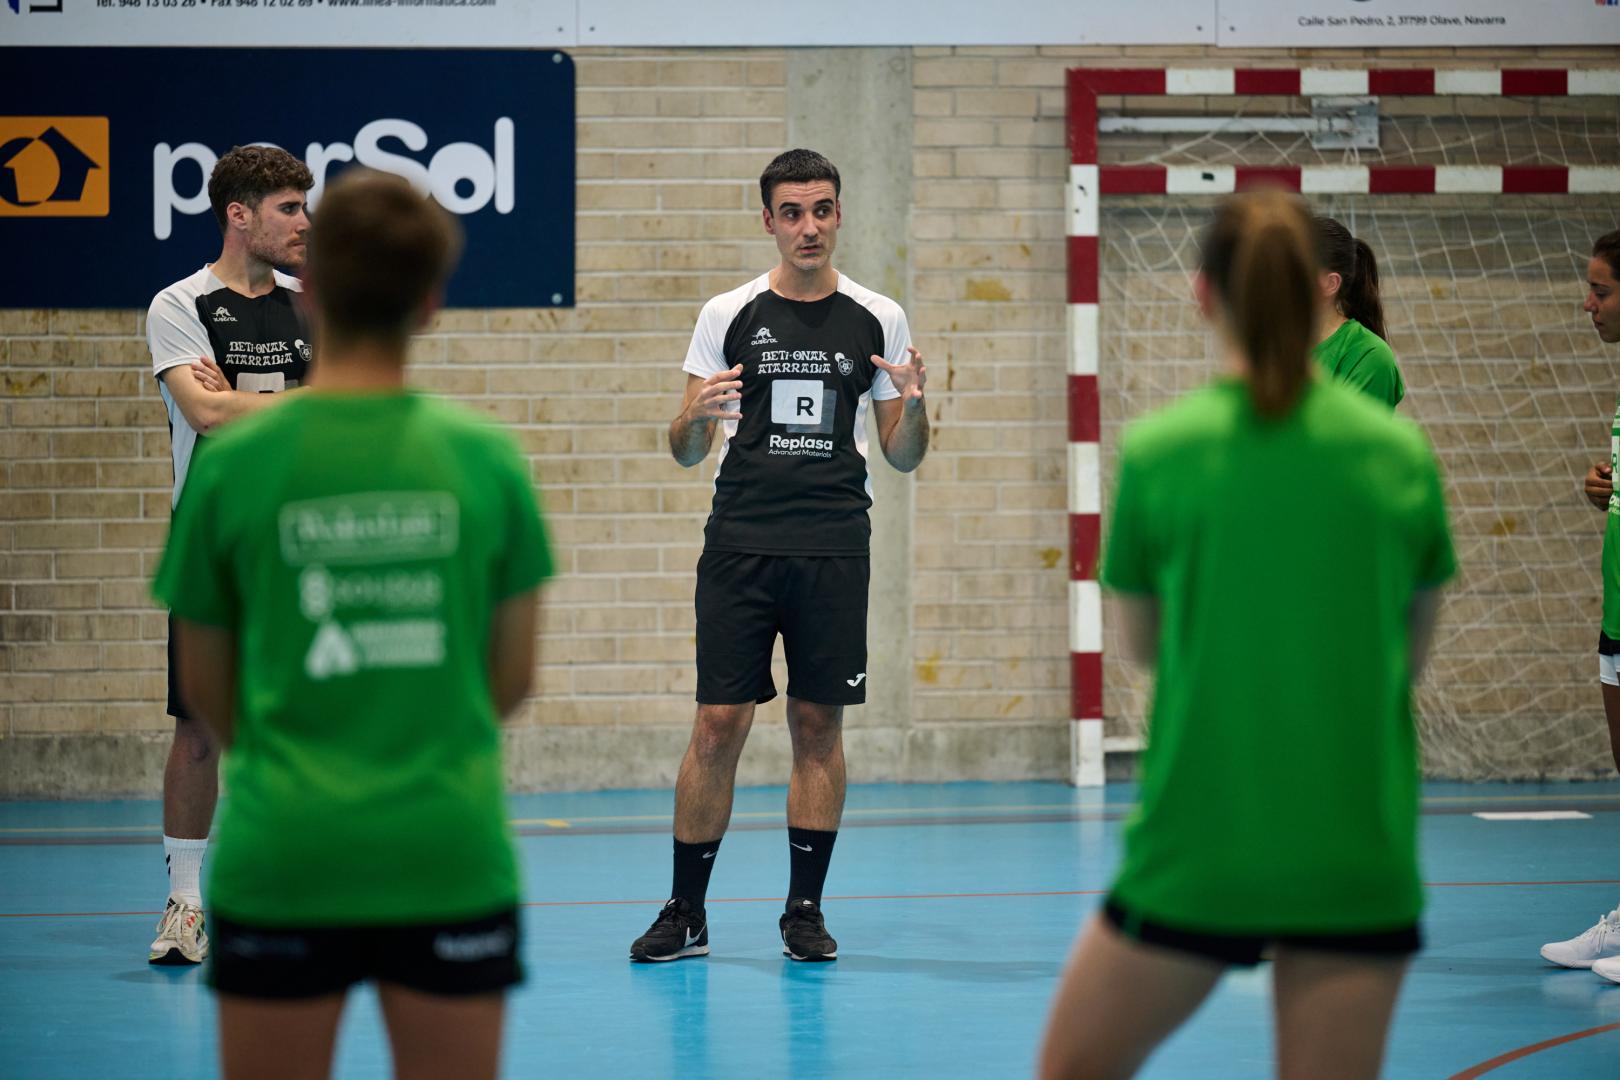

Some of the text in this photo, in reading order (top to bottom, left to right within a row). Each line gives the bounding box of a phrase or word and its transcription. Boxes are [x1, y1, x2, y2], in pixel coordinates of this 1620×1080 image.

[1298, 15, 1325, 26] Calle
[1327, 15, 1348, 26] San
[1349, 15, 1385, 26] Pedro,
[1464, 15, 1506, 26] Navarra
[153, 116, 515, 241] prSol
[796, 396, 815, 417] R
[769, 434, 834, 451] Replasa
[767, 448, 832, 459] Advanced Materials
